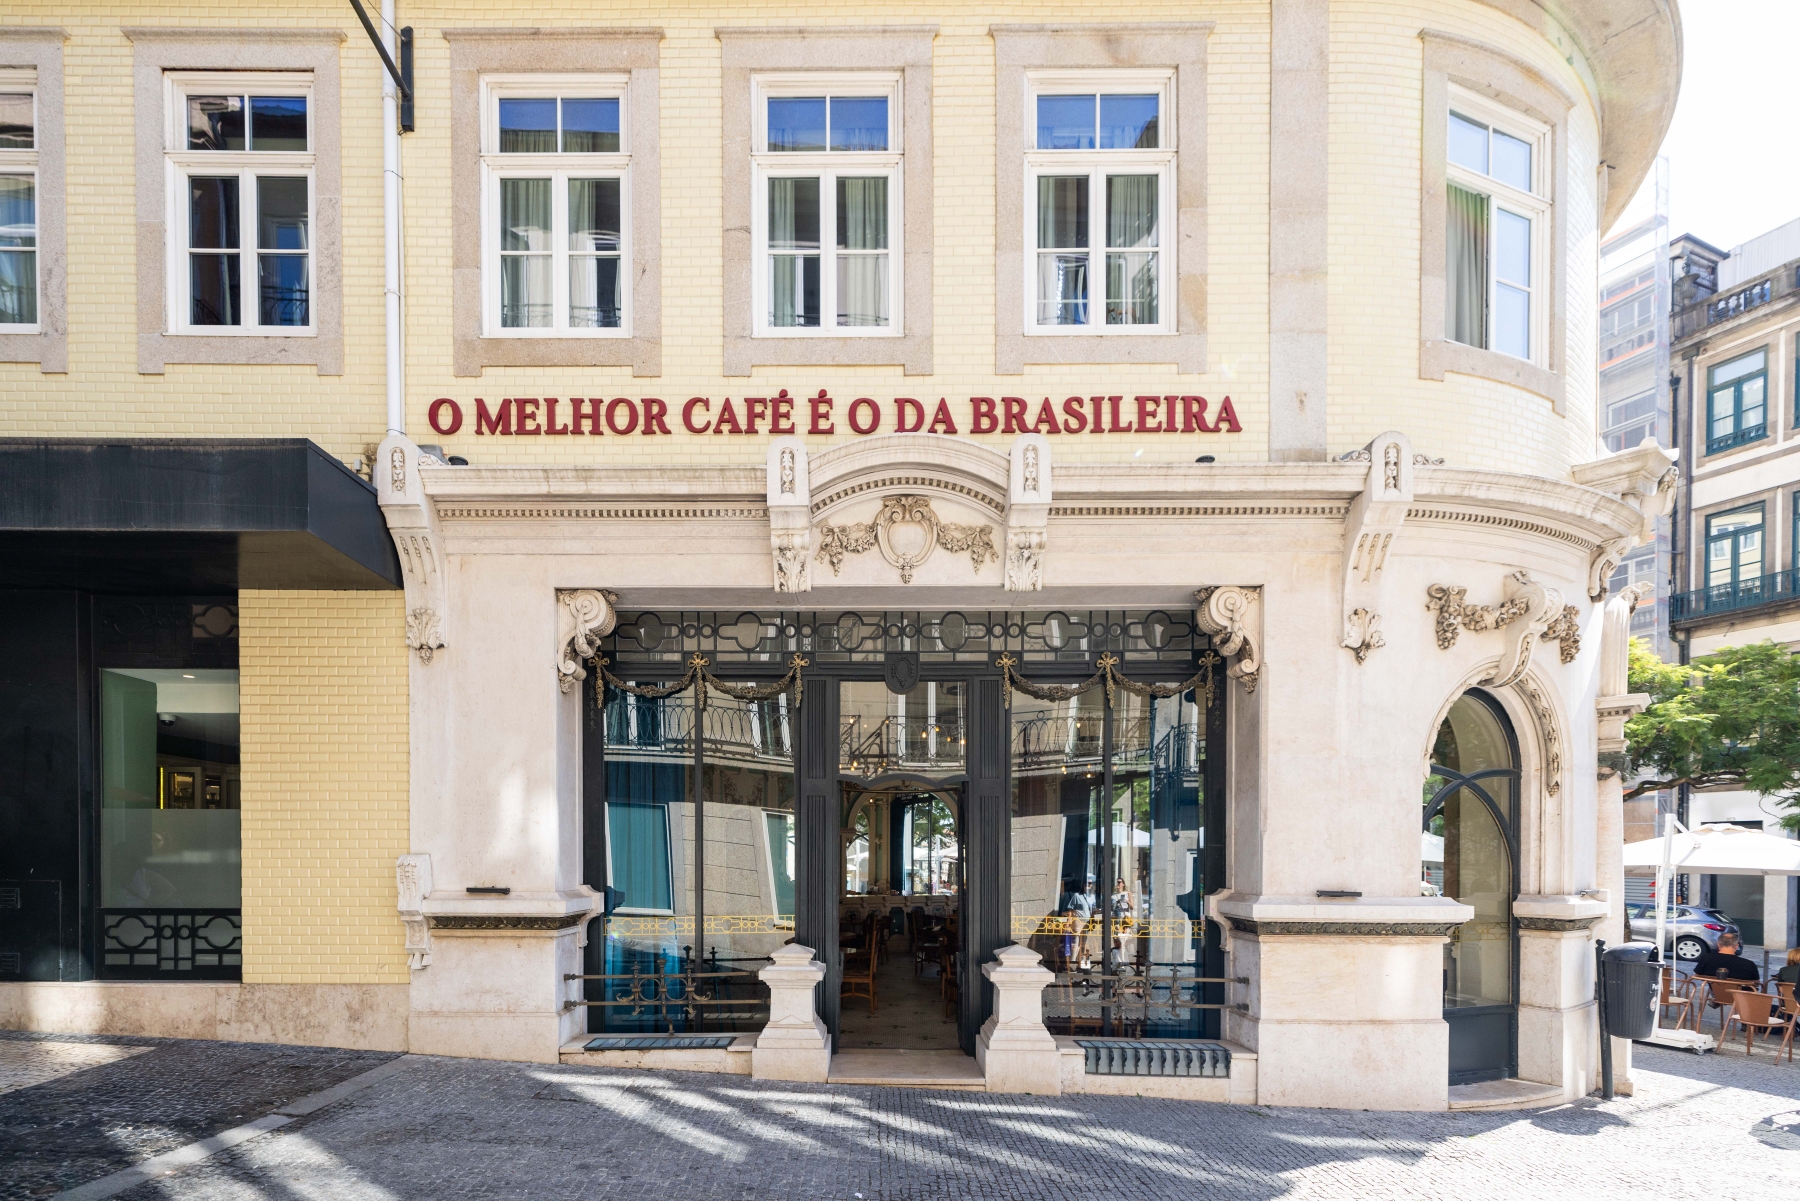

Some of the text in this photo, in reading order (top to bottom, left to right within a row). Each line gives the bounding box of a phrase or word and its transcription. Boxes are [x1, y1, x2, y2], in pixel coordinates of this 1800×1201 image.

[428, 388, 1243, 435] O MELHOR CAFÉ É O DA BRASILEIRA
